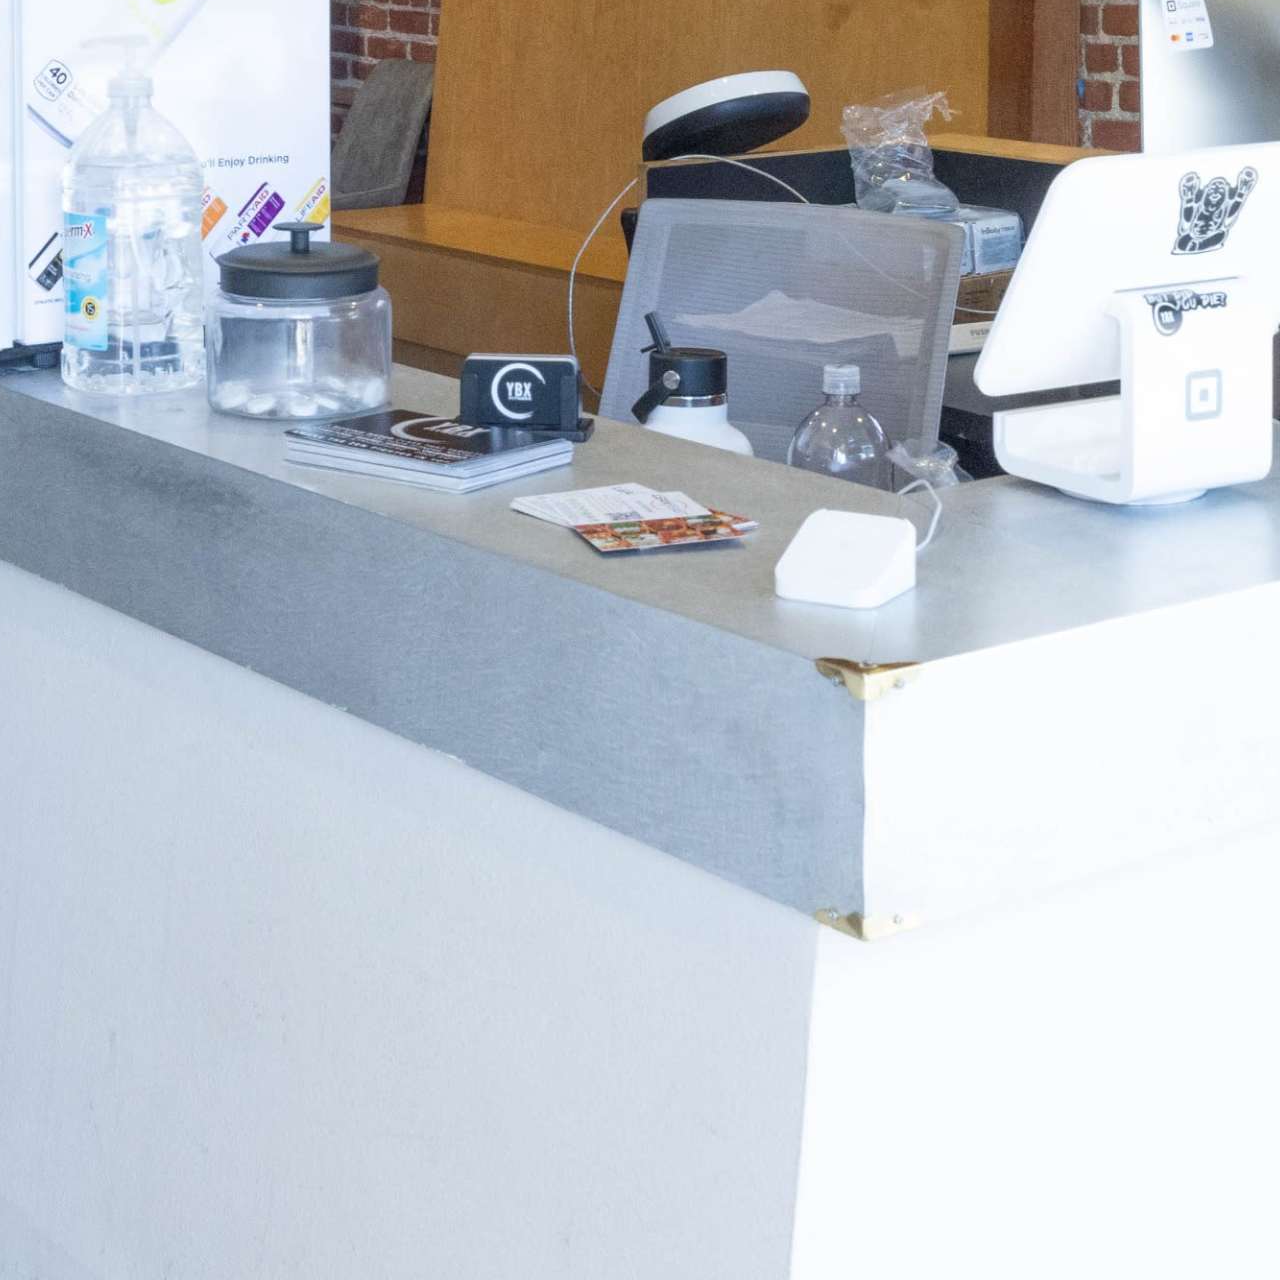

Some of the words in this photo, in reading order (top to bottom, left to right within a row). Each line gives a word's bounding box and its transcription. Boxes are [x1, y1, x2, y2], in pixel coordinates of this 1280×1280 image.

[49, 67, 67, 85] 40
[218, 158, 245, 169] Enjoy
[248, 155, 289, 166] Drinking
[227, 190, 270, 240] PARTYAID
[506, 381, 532, 397] YBX
